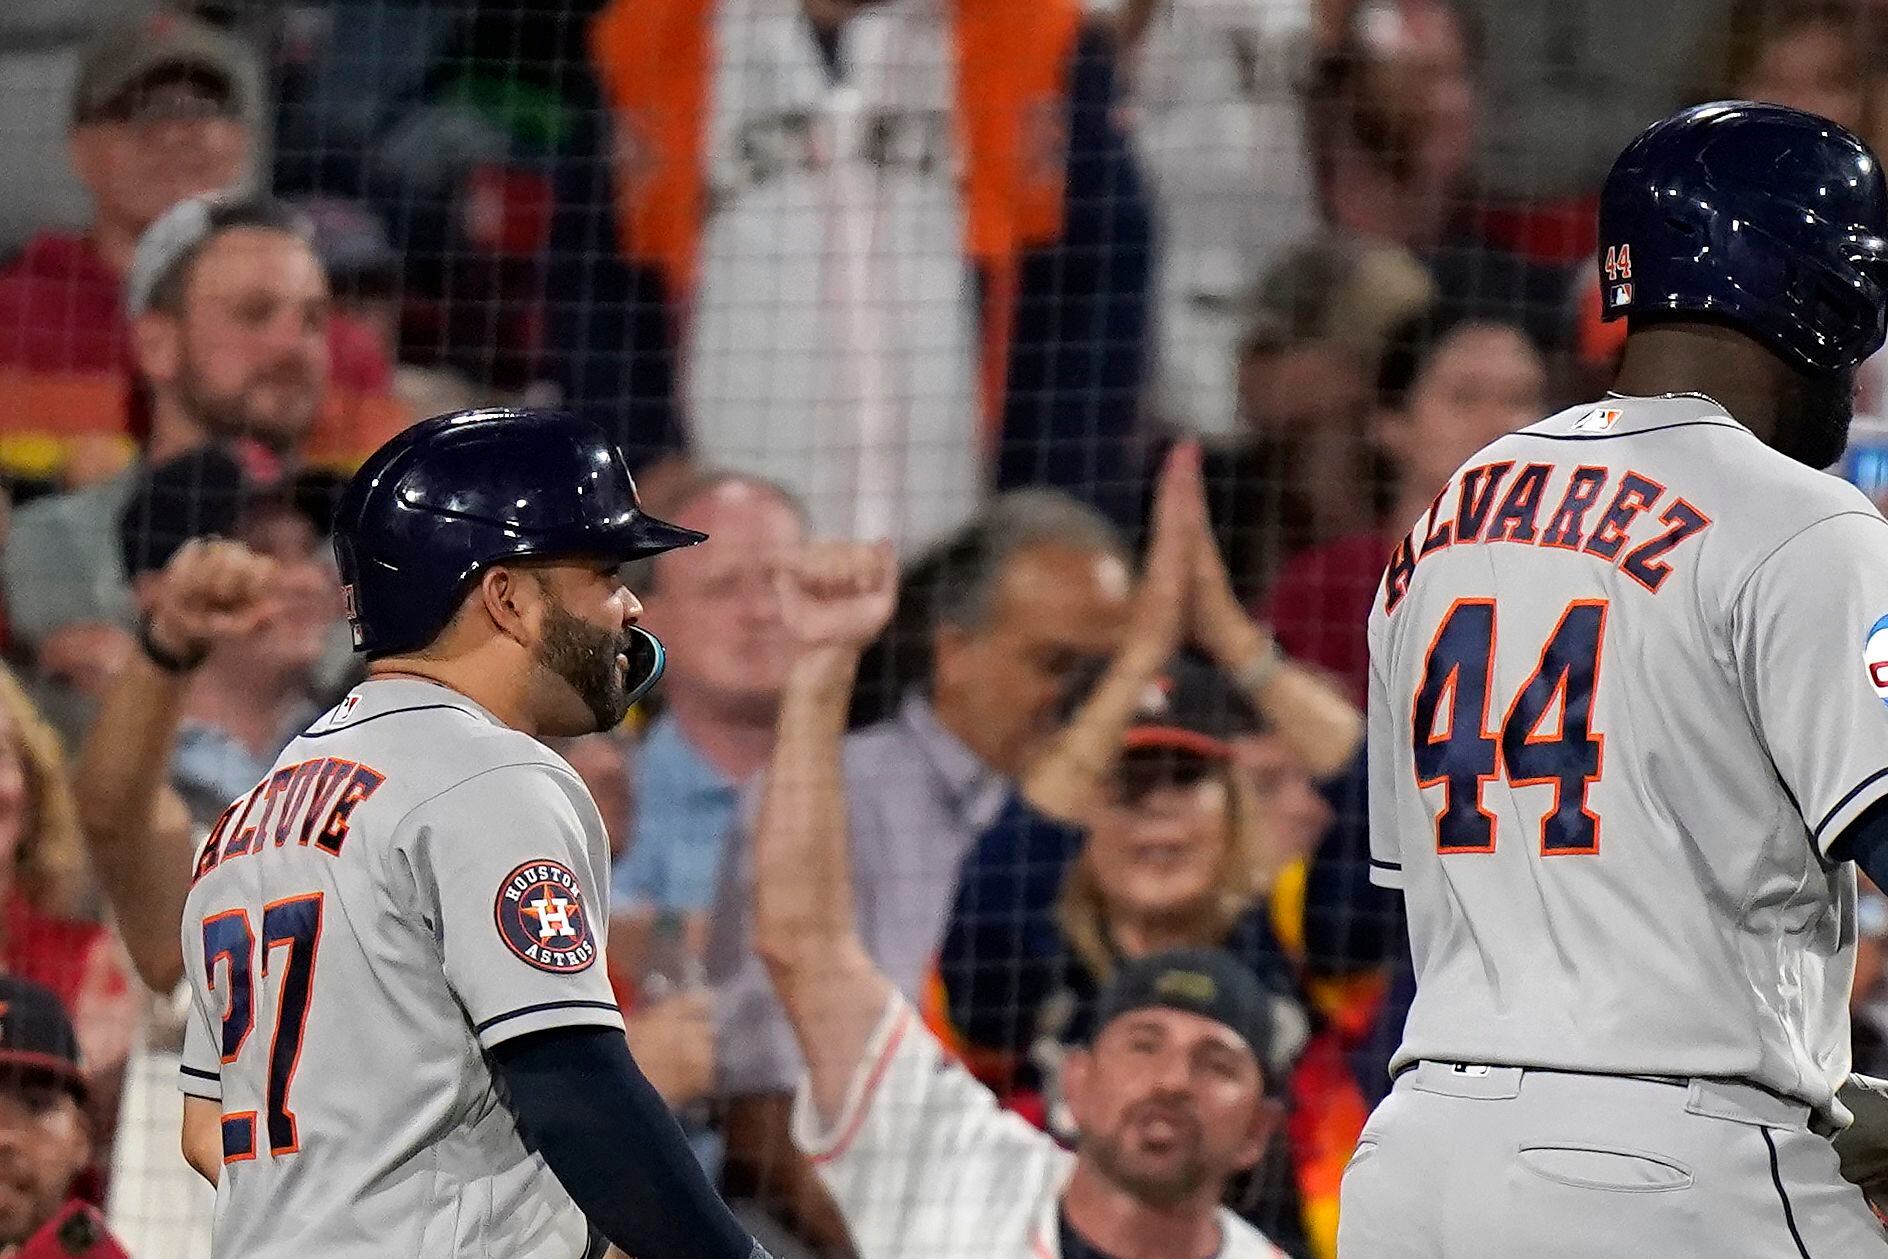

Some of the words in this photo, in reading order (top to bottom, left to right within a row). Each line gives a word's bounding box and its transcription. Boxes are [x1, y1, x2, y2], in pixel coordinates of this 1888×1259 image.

[1605, 244, 1631, 280] 44
[1385, 460, 1713, 617] ALVAREZ
[1412, 597, 1610, 857] 44
[190, 756, 386, 890] ALTUVE
[505, 865, 580, 902] HOUSTON
[531, 898, 576, 937] H
[525, 940, 593, 966] ASTROS
[202, 891, 325, 1165] 27
